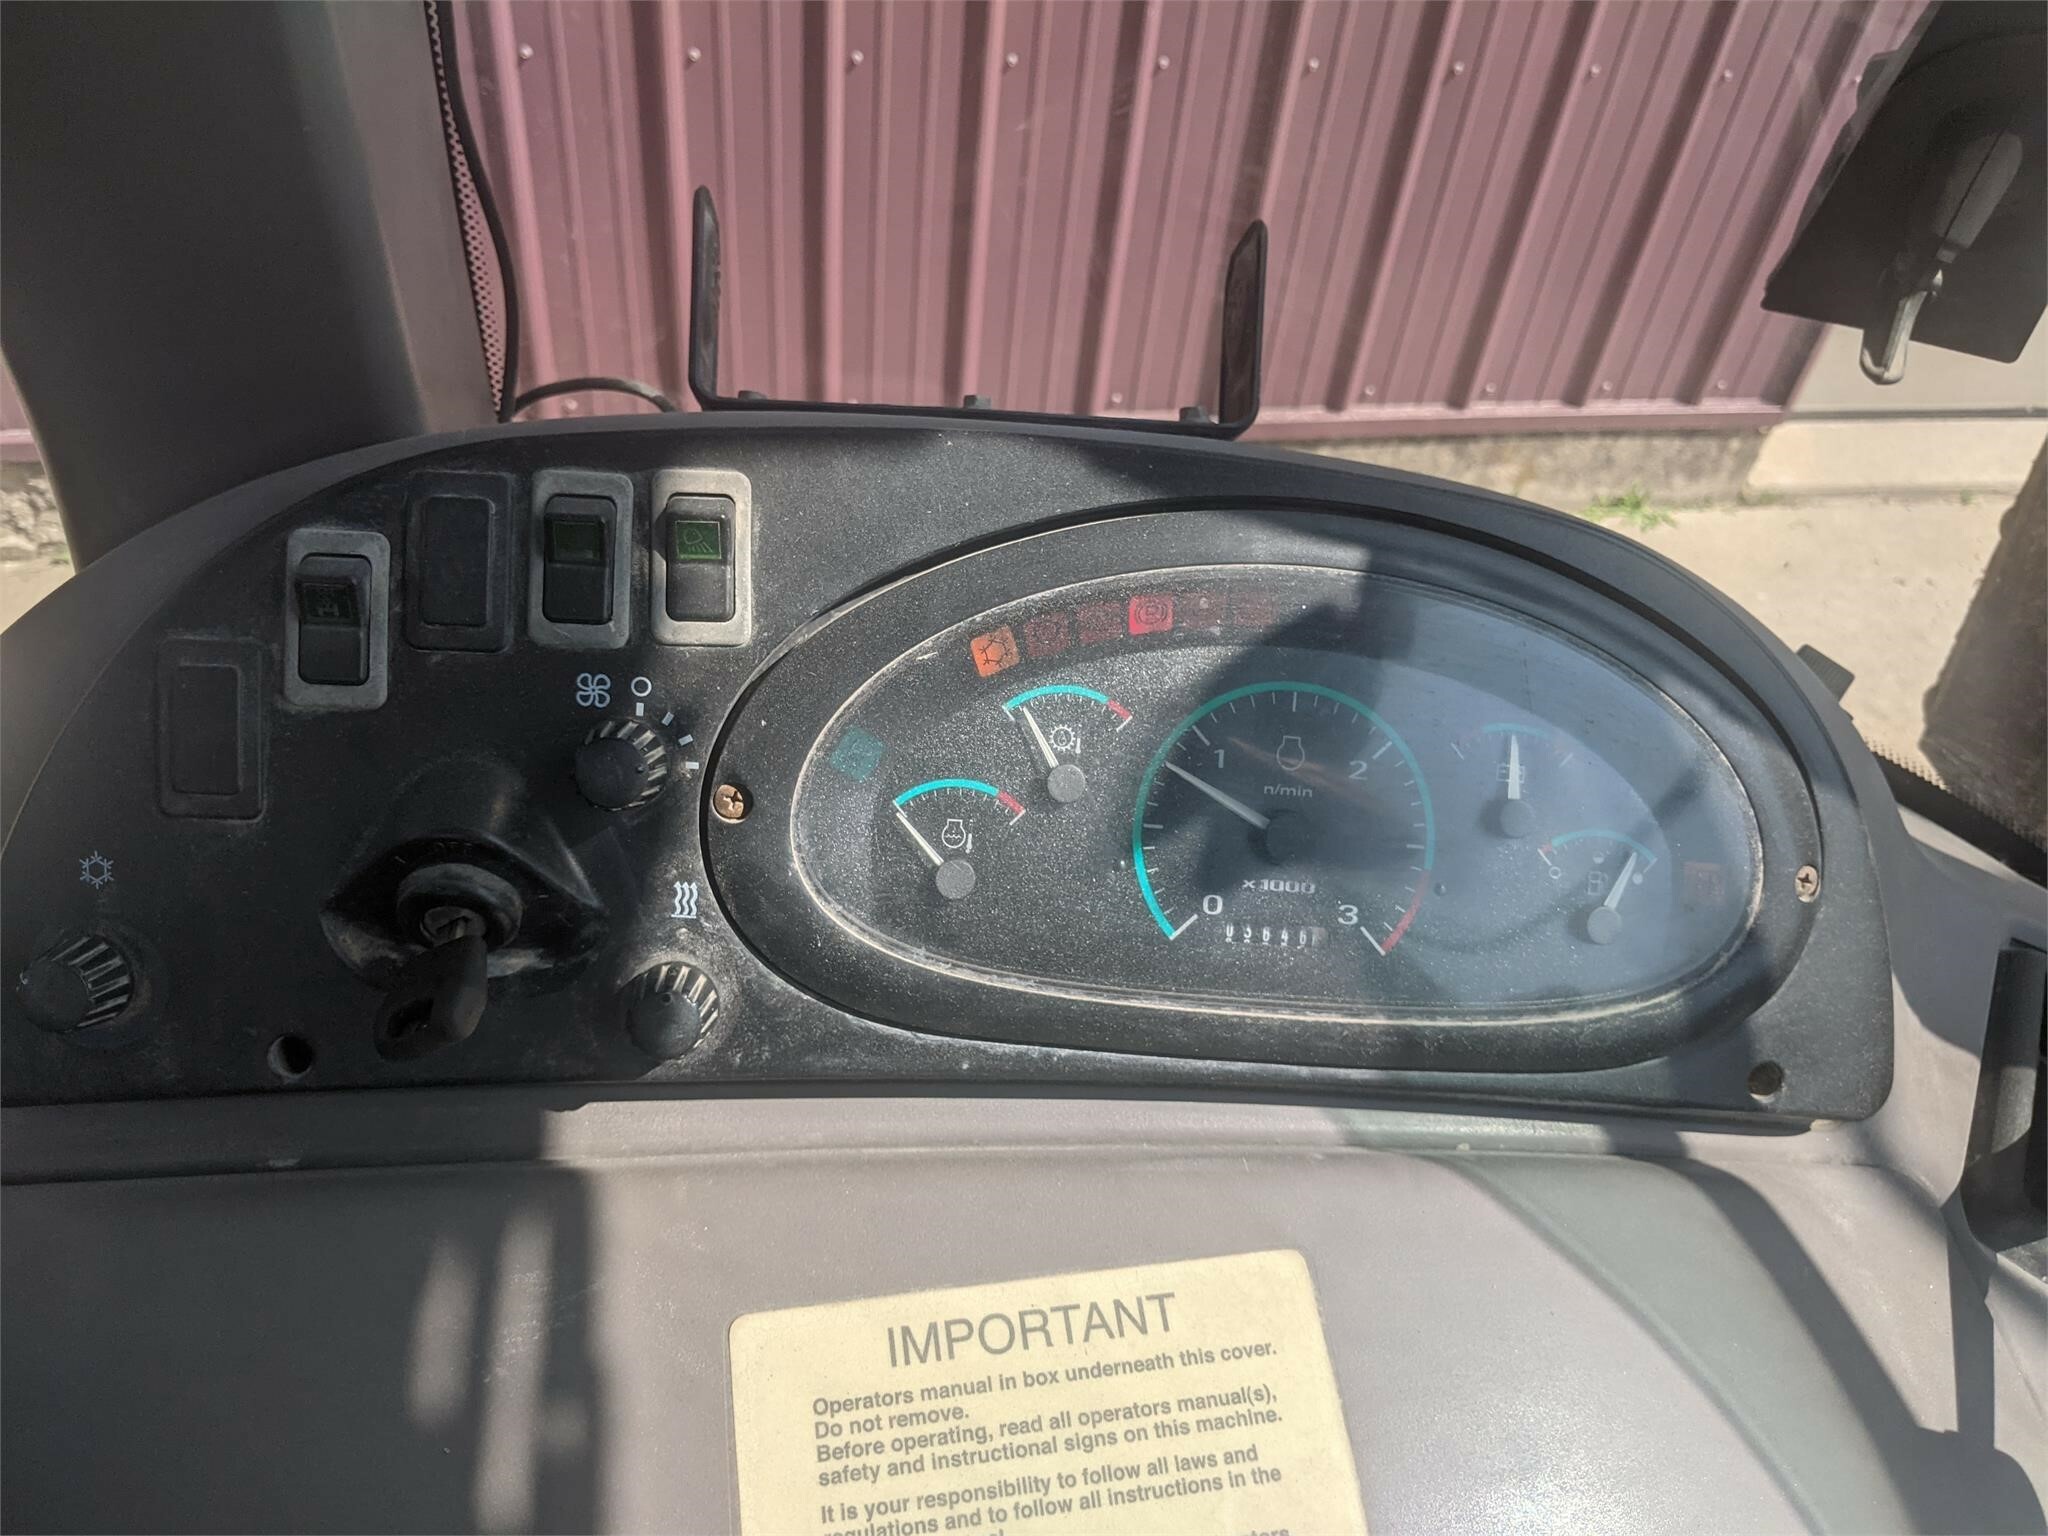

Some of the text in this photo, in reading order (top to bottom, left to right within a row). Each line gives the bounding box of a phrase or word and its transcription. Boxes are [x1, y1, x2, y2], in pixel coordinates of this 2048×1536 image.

[1213, 748, 1225, 769] 1
[1348, 760, 1368, 781] 2
[1263, 783, 1313, 798] n/min
[1202, 894, 1224, 916] 0
[1337, 904, 1359, 926] 3
[887, 1292, 1176, 1368] IMPORTANT
[812, 1341, 1277, 1418] Operators manual in box underneath this cover.
[814, 1405, 970, 1439] Do not remove.
[816, 1383, 1277, 1463] Before operating, read all operators manual(s),
[818, 1408, 1283, 1487] safety and instructional signs on this machine.
[821, 1444, 1259, 1524] It is your responsibility to follow all laws and
[823, 1465, 1282, 1536] ulations and to follow all instructions in the
